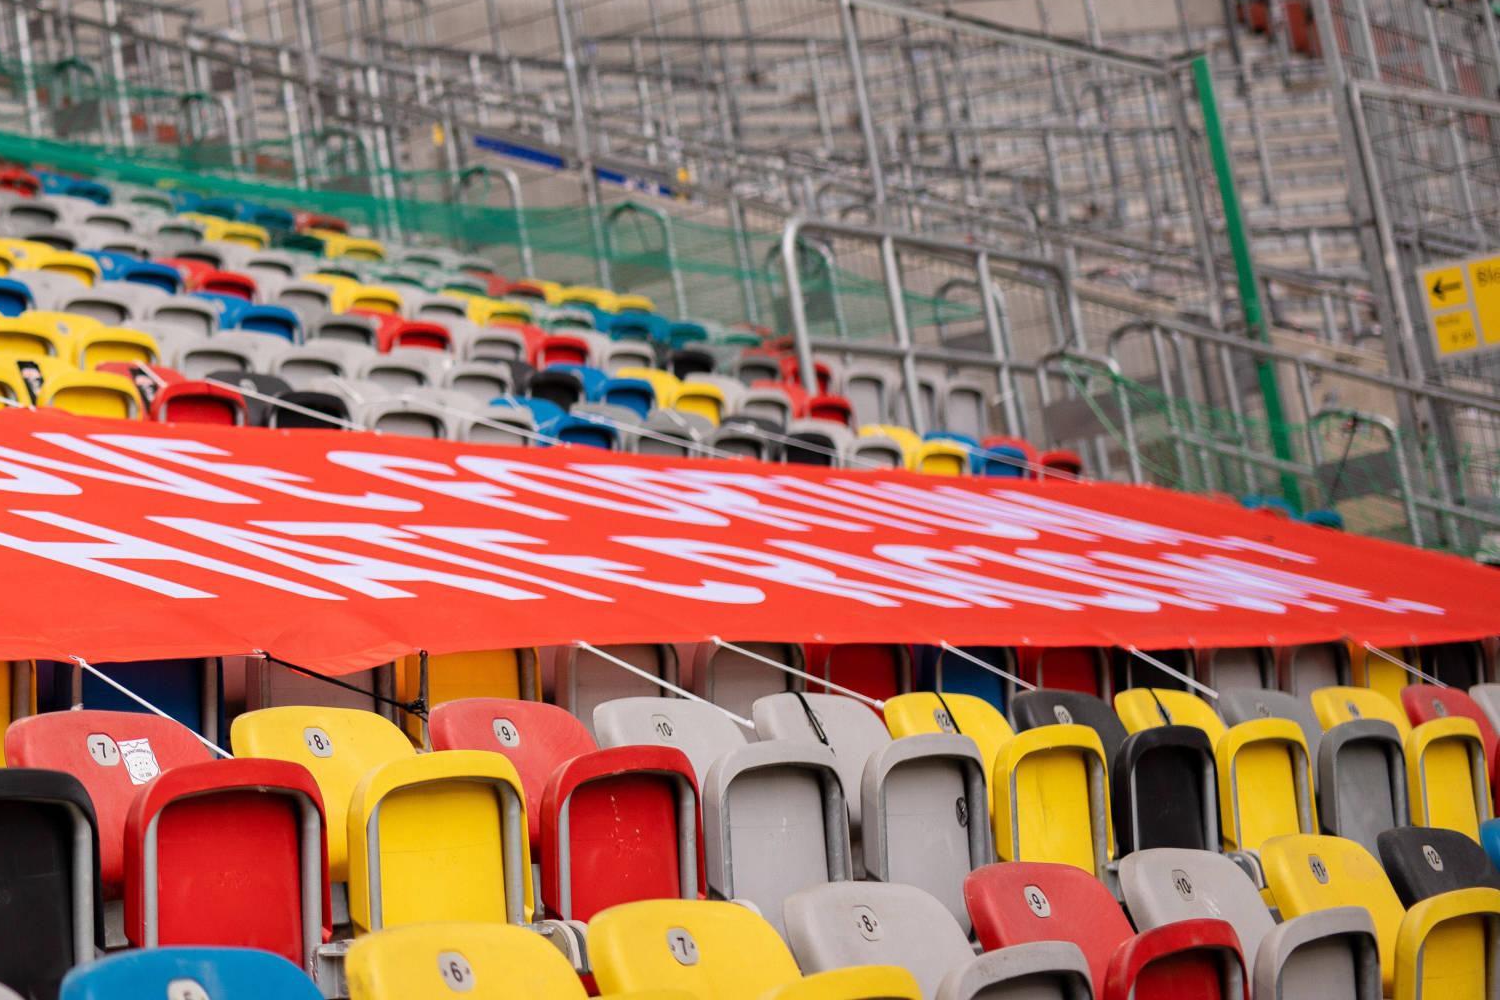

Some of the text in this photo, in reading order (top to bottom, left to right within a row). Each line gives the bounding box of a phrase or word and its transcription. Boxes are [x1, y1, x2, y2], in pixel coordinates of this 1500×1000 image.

[608, 535, 1446, 615] RACISM!
[501, 725, 512, 742] 9
[657, 721, 672, 738] 10
[97, 742, 107, 759] 7
[314, 733, 324, 751] 8
[1426, 850, 1441, 867] 12
[1312, 860, 1326, 877] 11
[1177, 877, 1192, 895] 10
[1030, 892, 1042, 911] 9
[861, 915, 873, 932] 8
[676, 937, 689, 957] 7
[451, 962, 464, 983] 6
